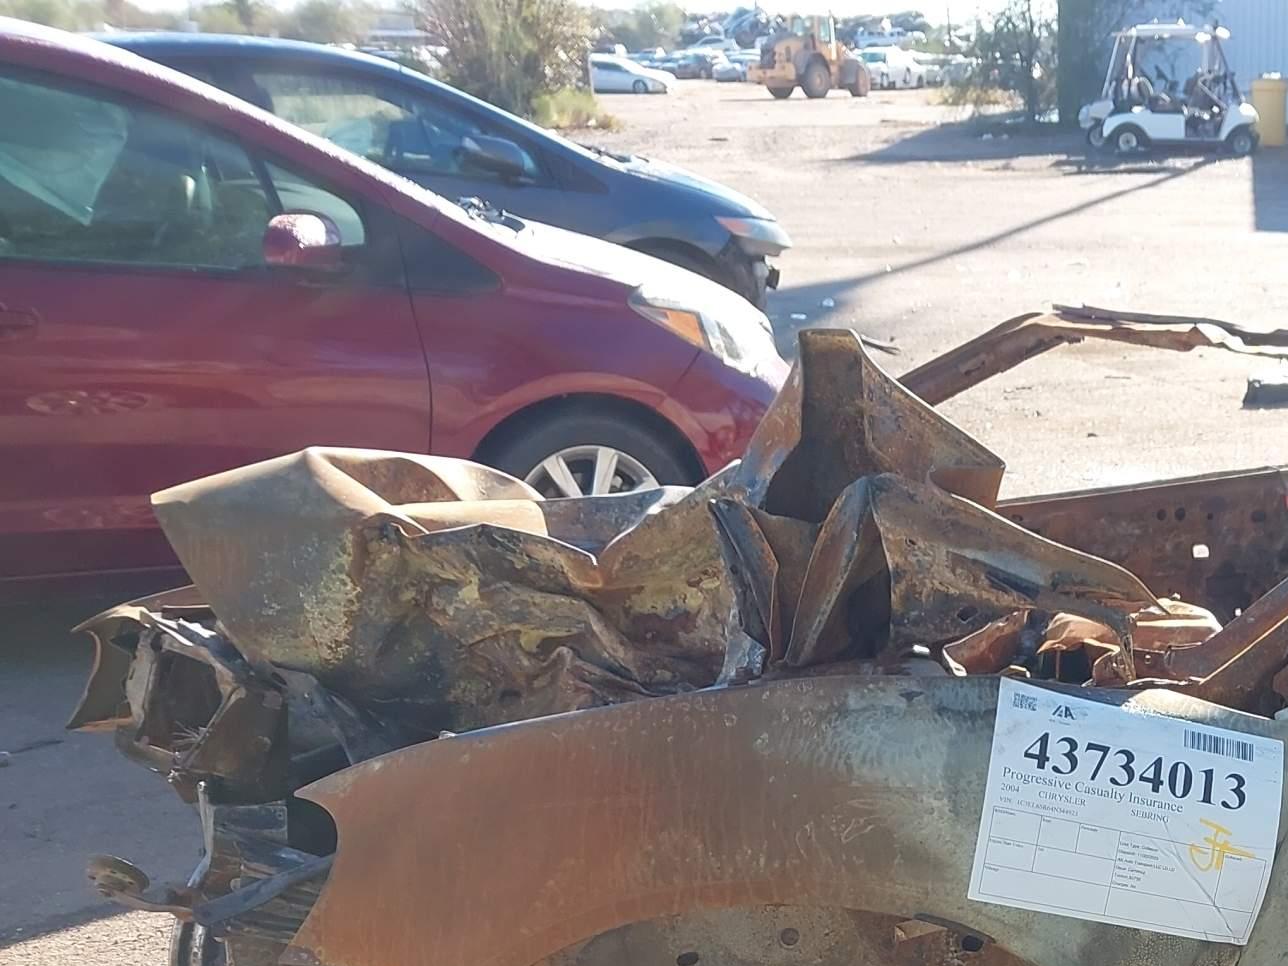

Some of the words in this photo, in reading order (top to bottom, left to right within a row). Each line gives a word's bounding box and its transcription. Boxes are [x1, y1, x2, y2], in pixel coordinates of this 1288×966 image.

[1002, 766, 1072, 790] Progressive
[1075, 781, 1125, 804] Casualty
[1128, 792, 1184, 814] Insurance
[1023, 731, 1247, 811] 43734013
[1000, 782, 1020, 793] 2004
[1038, 790, 1087, 807] CHRYSLER
[1130, 809, 1170, 824] SEBRING
